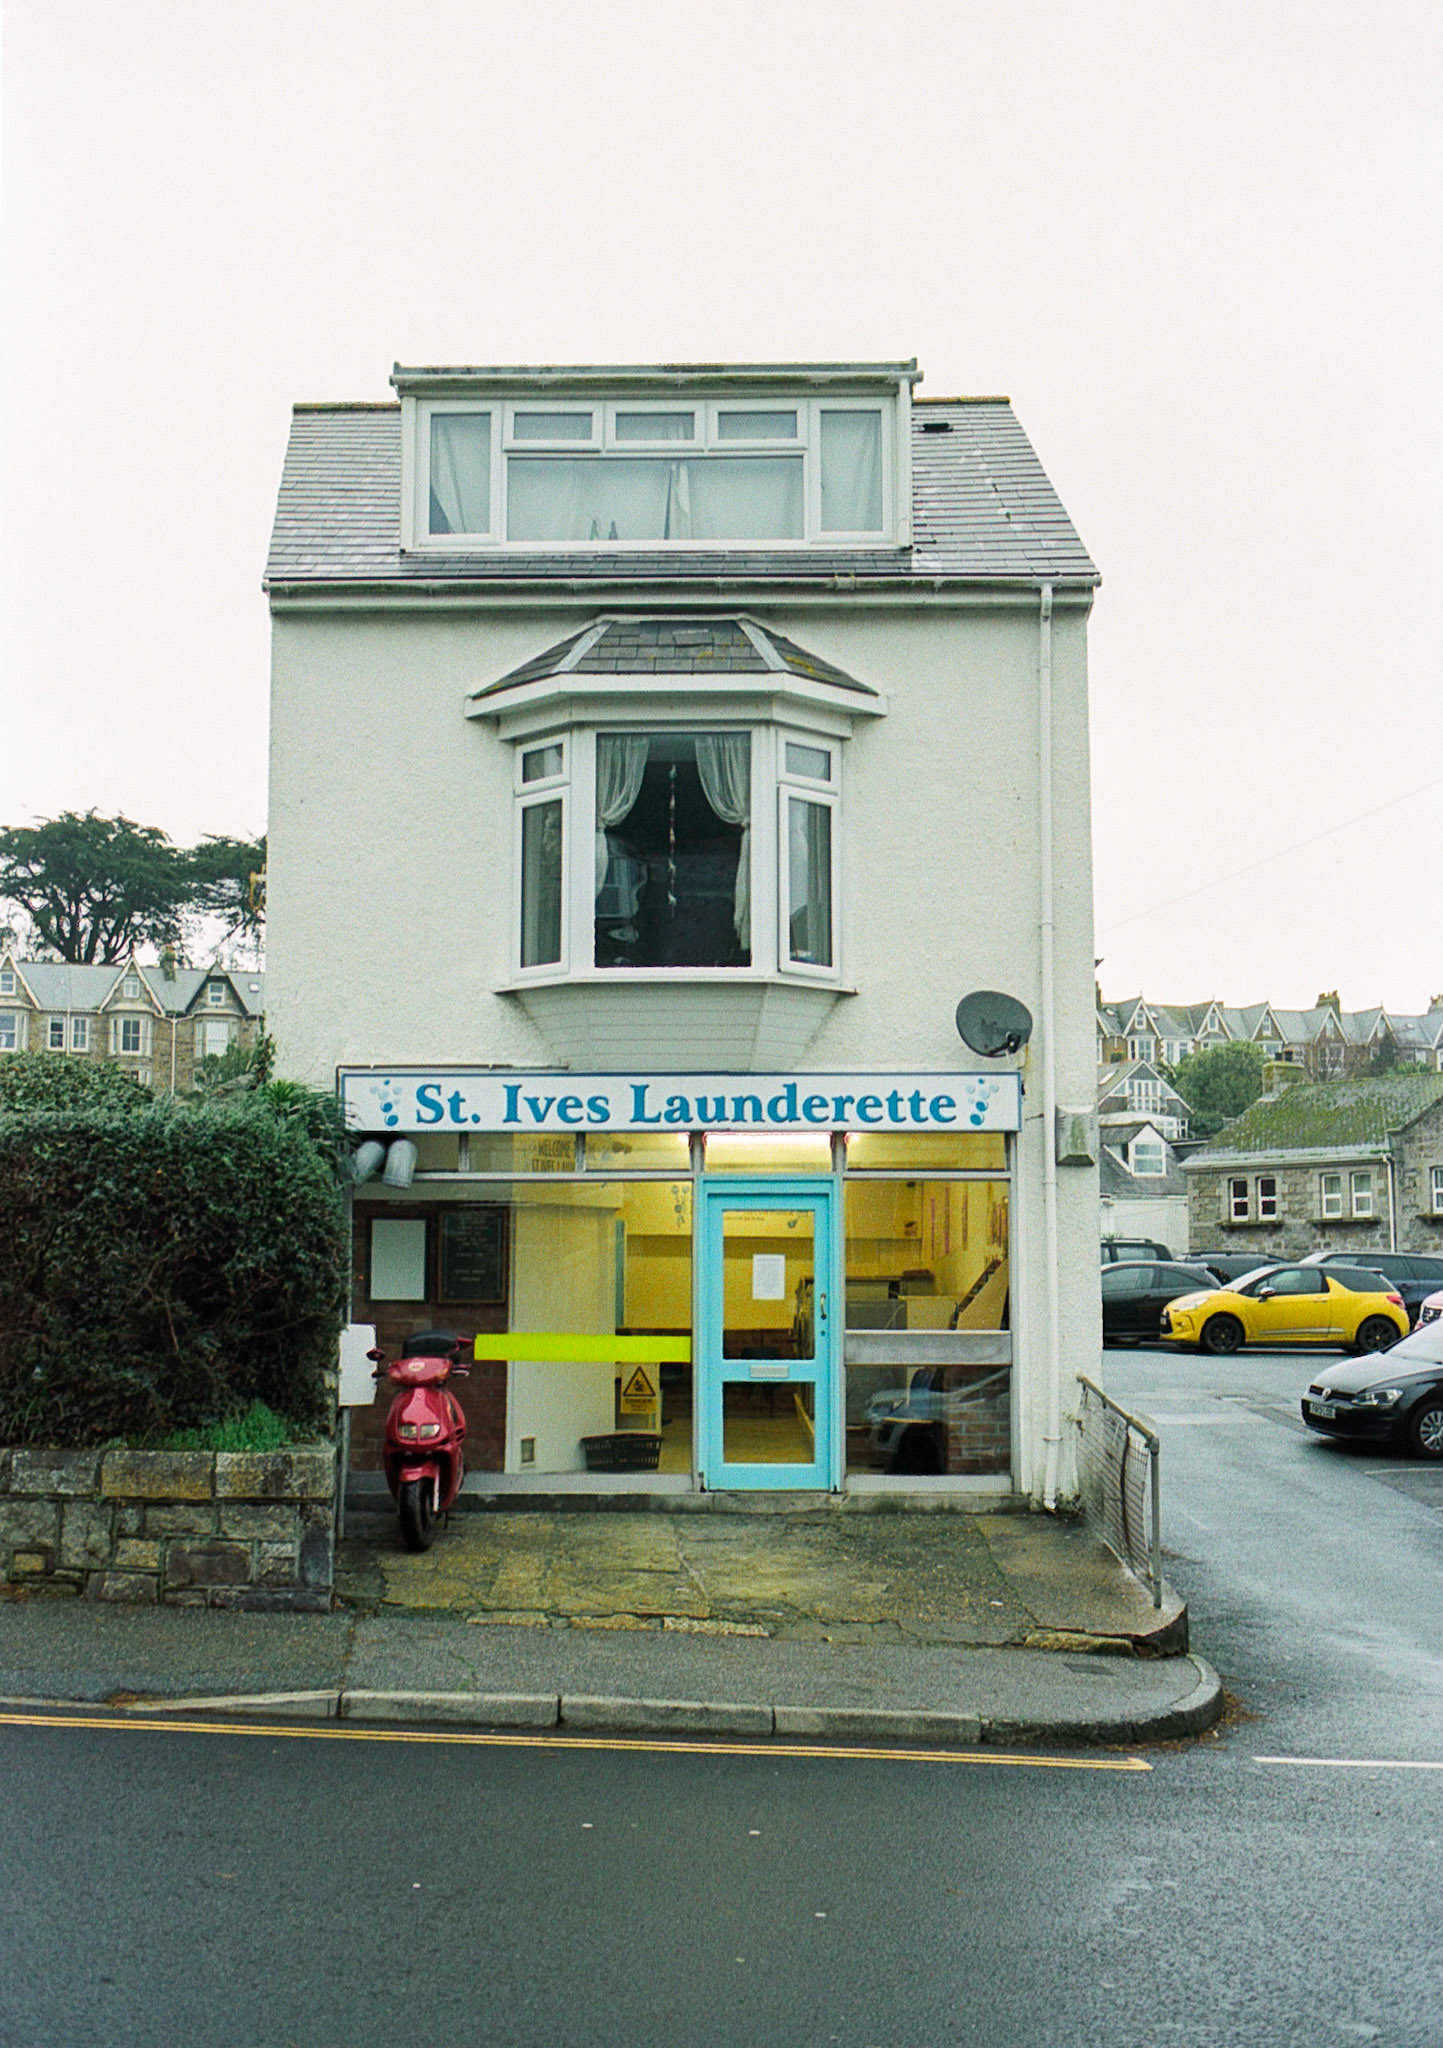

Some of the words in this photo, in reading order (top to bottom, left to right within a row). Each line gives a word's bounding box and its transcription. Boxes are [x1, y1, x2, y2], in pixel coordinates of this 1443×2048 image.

[415, 1083, 481, 1124] St.
[502, 1084, 611, 1124] Ives
[629, 1082, 957, 1125] Launderette
